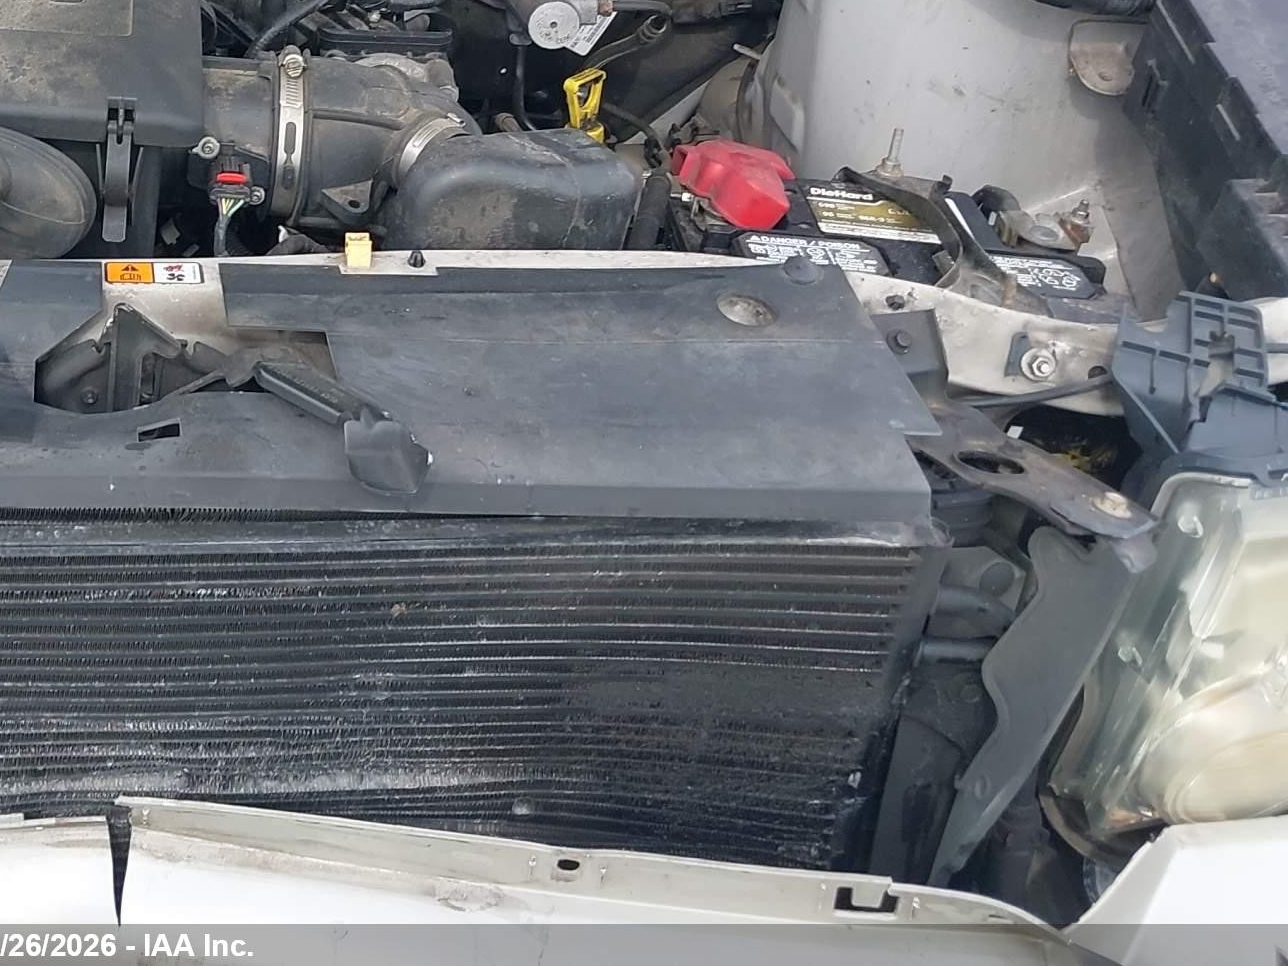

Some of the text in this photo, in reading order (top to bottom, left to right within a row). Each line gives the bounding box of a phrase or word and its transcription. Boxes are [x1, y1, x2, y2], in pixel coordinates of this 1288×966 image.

[809, 187, 874, 201] DieHard
[759, 236, 808, 247] DANGER
[817, 240, 861, 251] POISON
